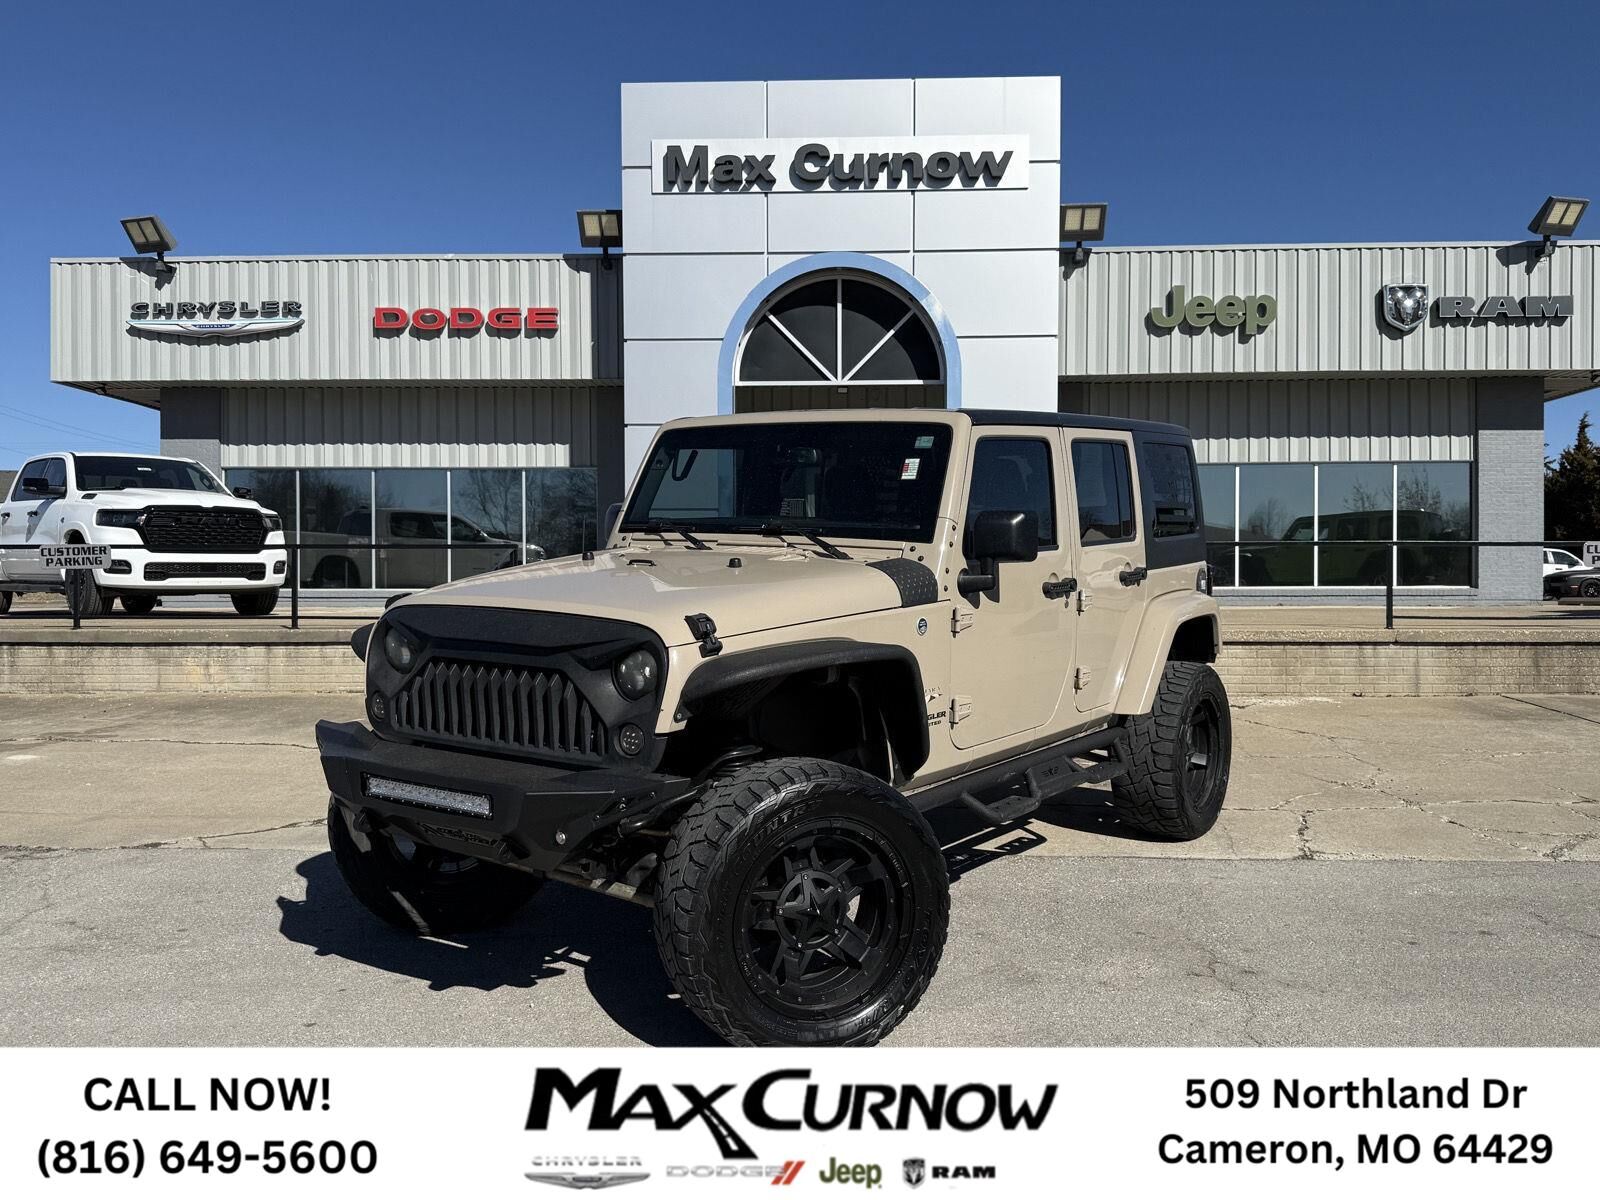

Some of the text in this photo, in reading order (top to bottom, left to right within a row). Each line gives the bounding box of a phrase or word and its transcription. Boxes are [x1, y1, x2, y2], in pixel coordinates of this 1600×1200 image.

[666, 143, 1014, 183] Max Curnow
[130, 301, 302, 315] CHRYSLER
[1151, 285, 1277, 334] Jeep
[1440, 295, 1575, 317] RAM
[375, 307, 559, 330] DODGE
[41, 546, 107, 557] CUSTOMER
[46, 556, 103, 567] PARKING
